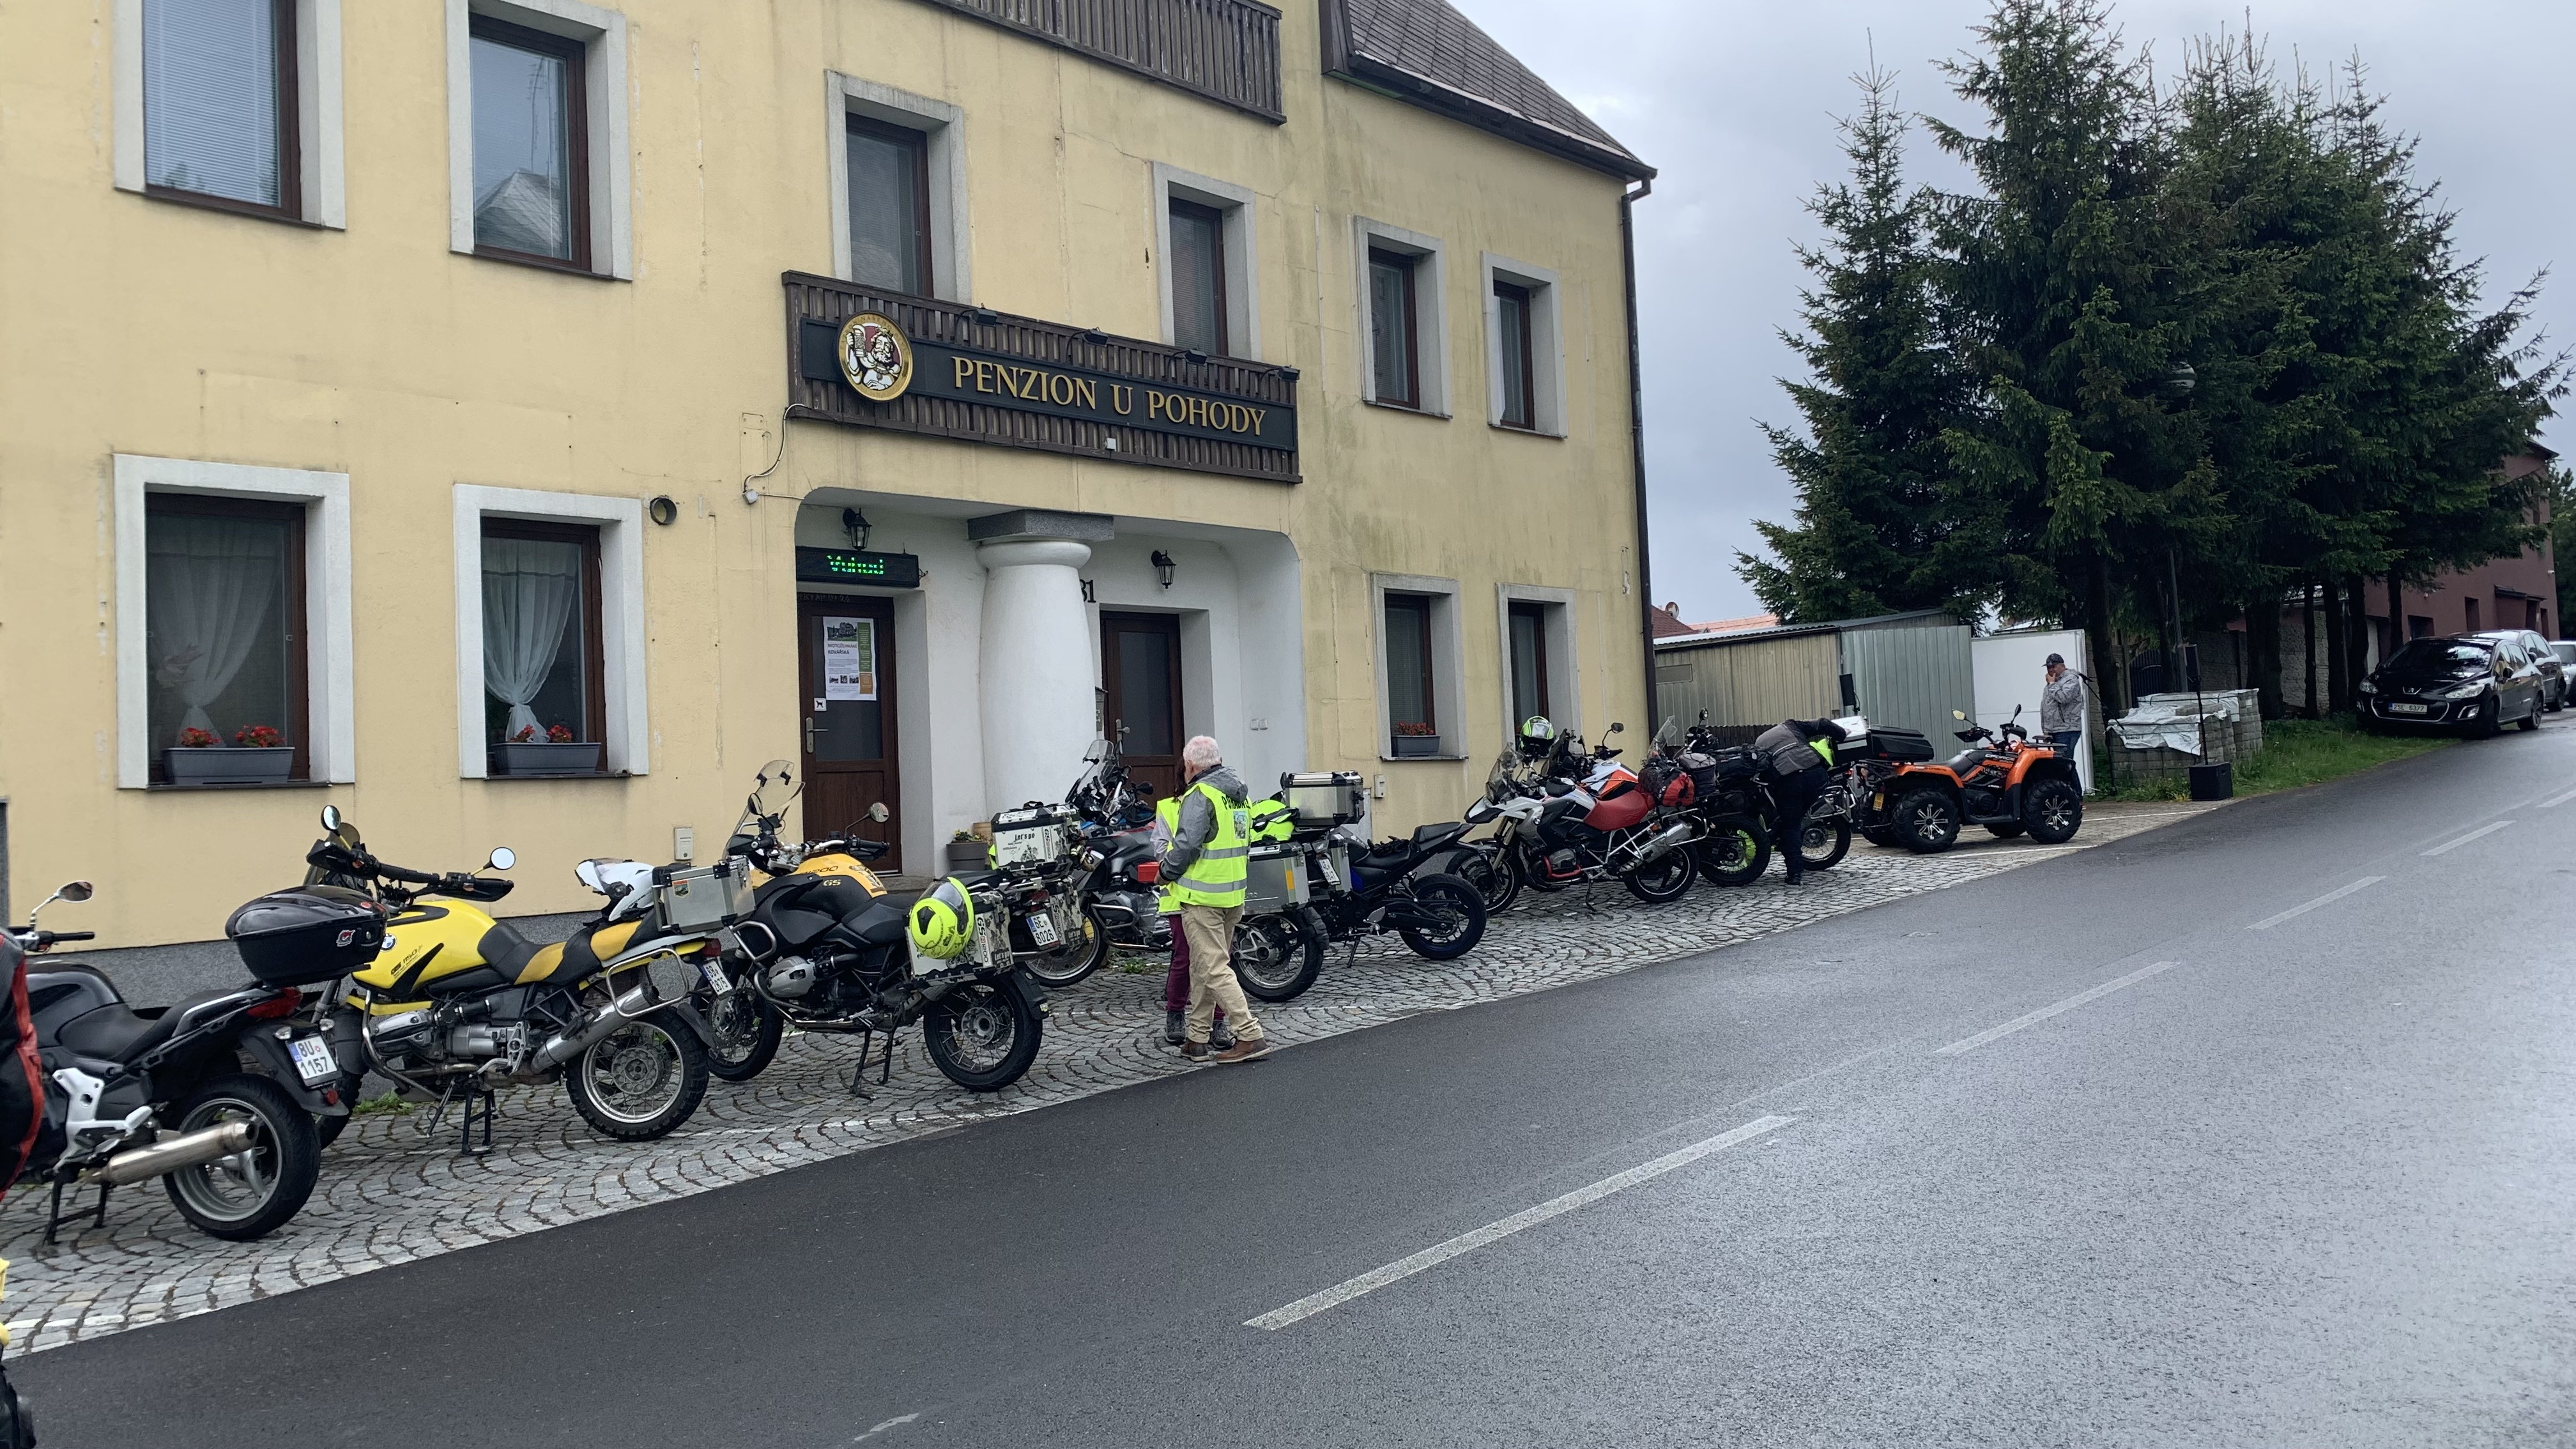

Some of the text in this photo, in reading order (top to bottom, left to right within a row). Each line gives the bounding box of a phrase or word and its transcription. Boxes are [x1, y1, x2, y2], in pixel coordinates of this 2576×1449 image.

[951, 356, 1266, 436] PENZION U POHODY
[977, 917, 986, 936] GS
[1033, 916, 1044, 929] 6E
[1035, 928, 1054, 944] 8026
[711, 977, 728, 992] 2875
[298, 1041, 315, 1057] 8U
[300, 1056, 328, 1077] 1157
